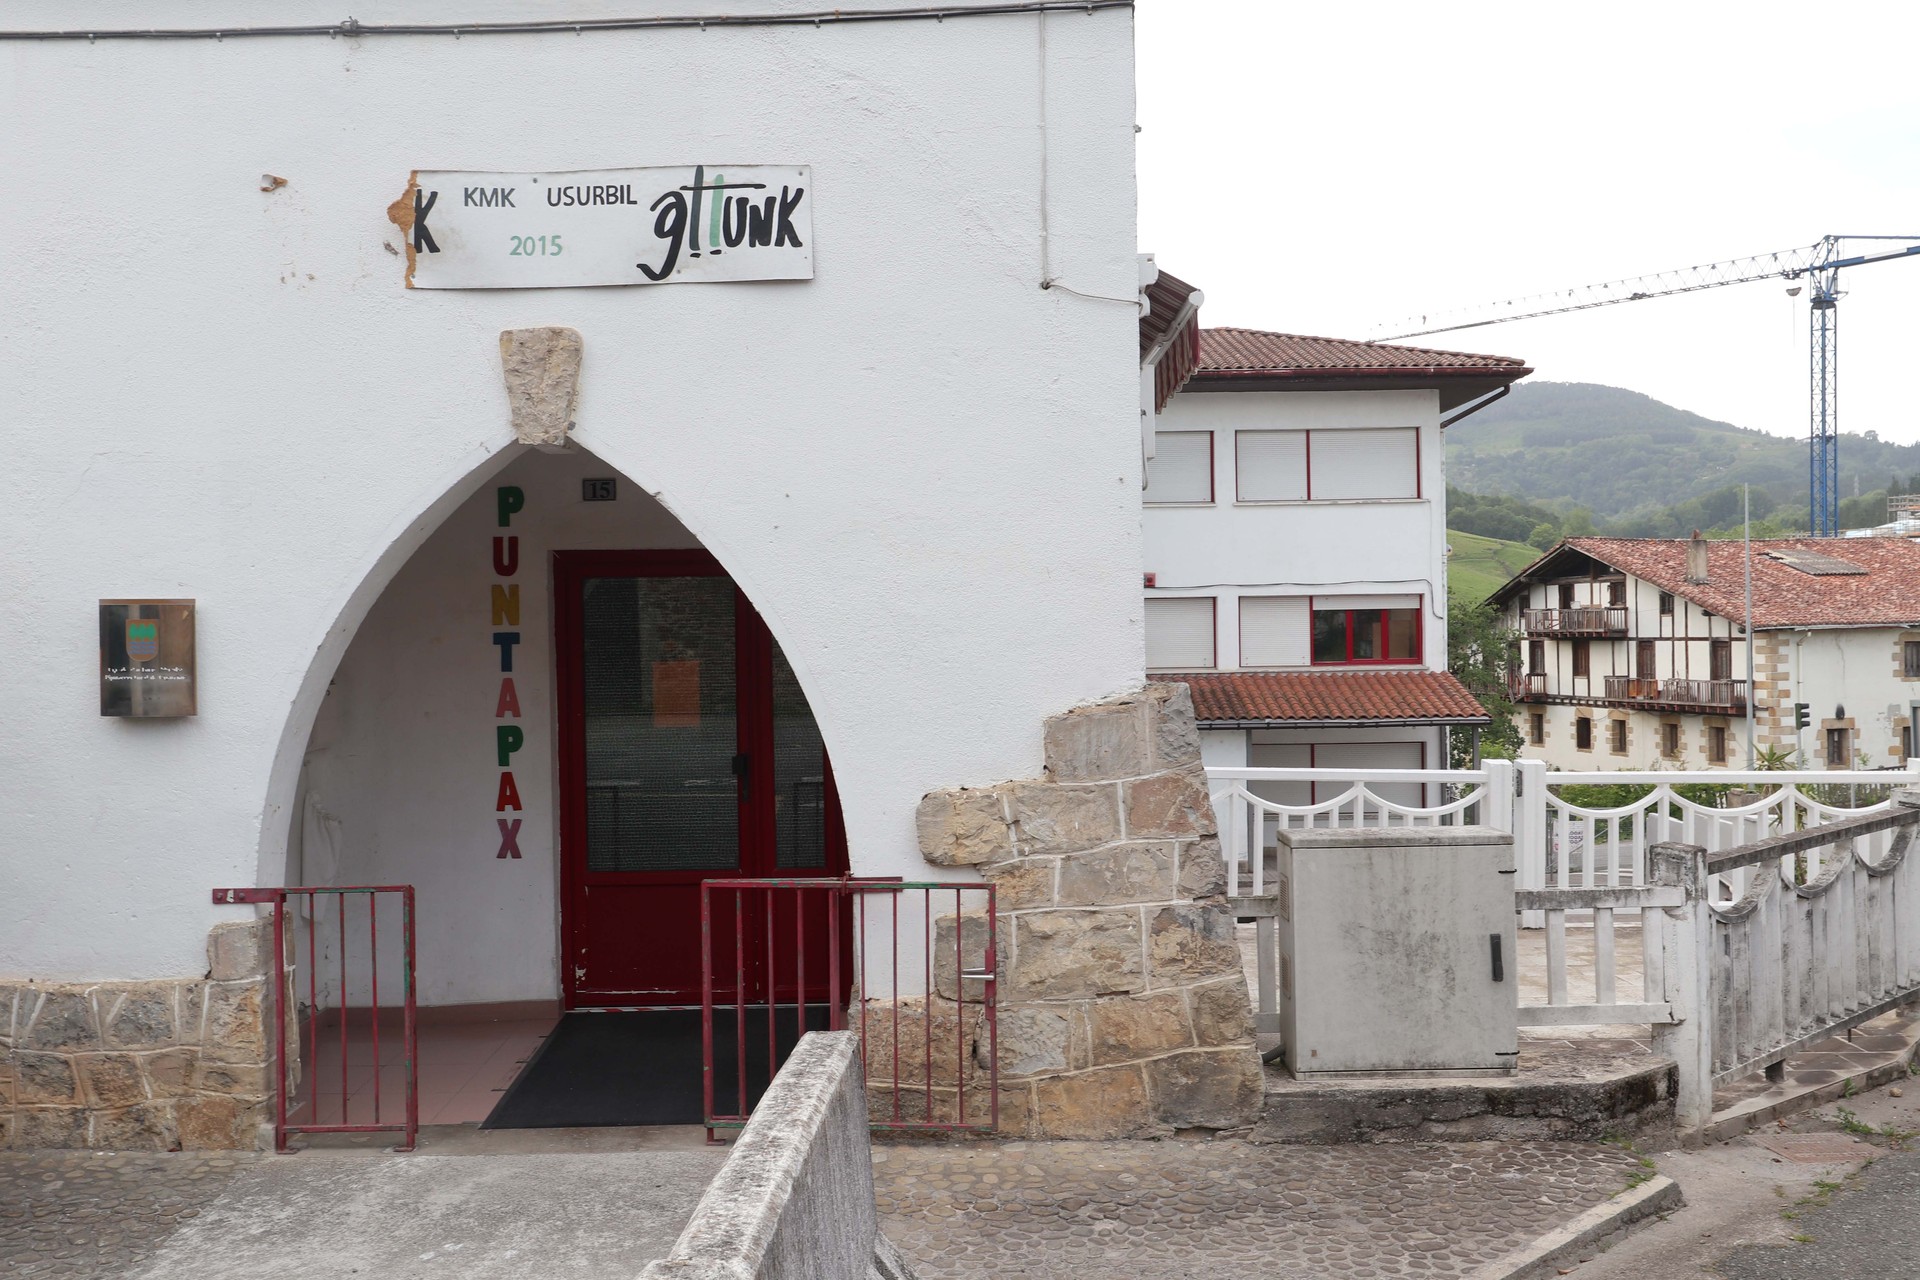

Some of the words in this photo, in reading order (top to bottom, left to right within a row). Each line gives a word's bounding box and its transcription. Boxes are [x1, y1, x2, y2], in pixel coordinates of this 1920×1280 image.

[463, 187, 516, 208] KMK
[547, 184, 637, 207] USURBIL
[509, 235, 563, 256] 2015
[589, 481, 610, 499] 15
[491, 486, 525, 859] PUNTAPAX
